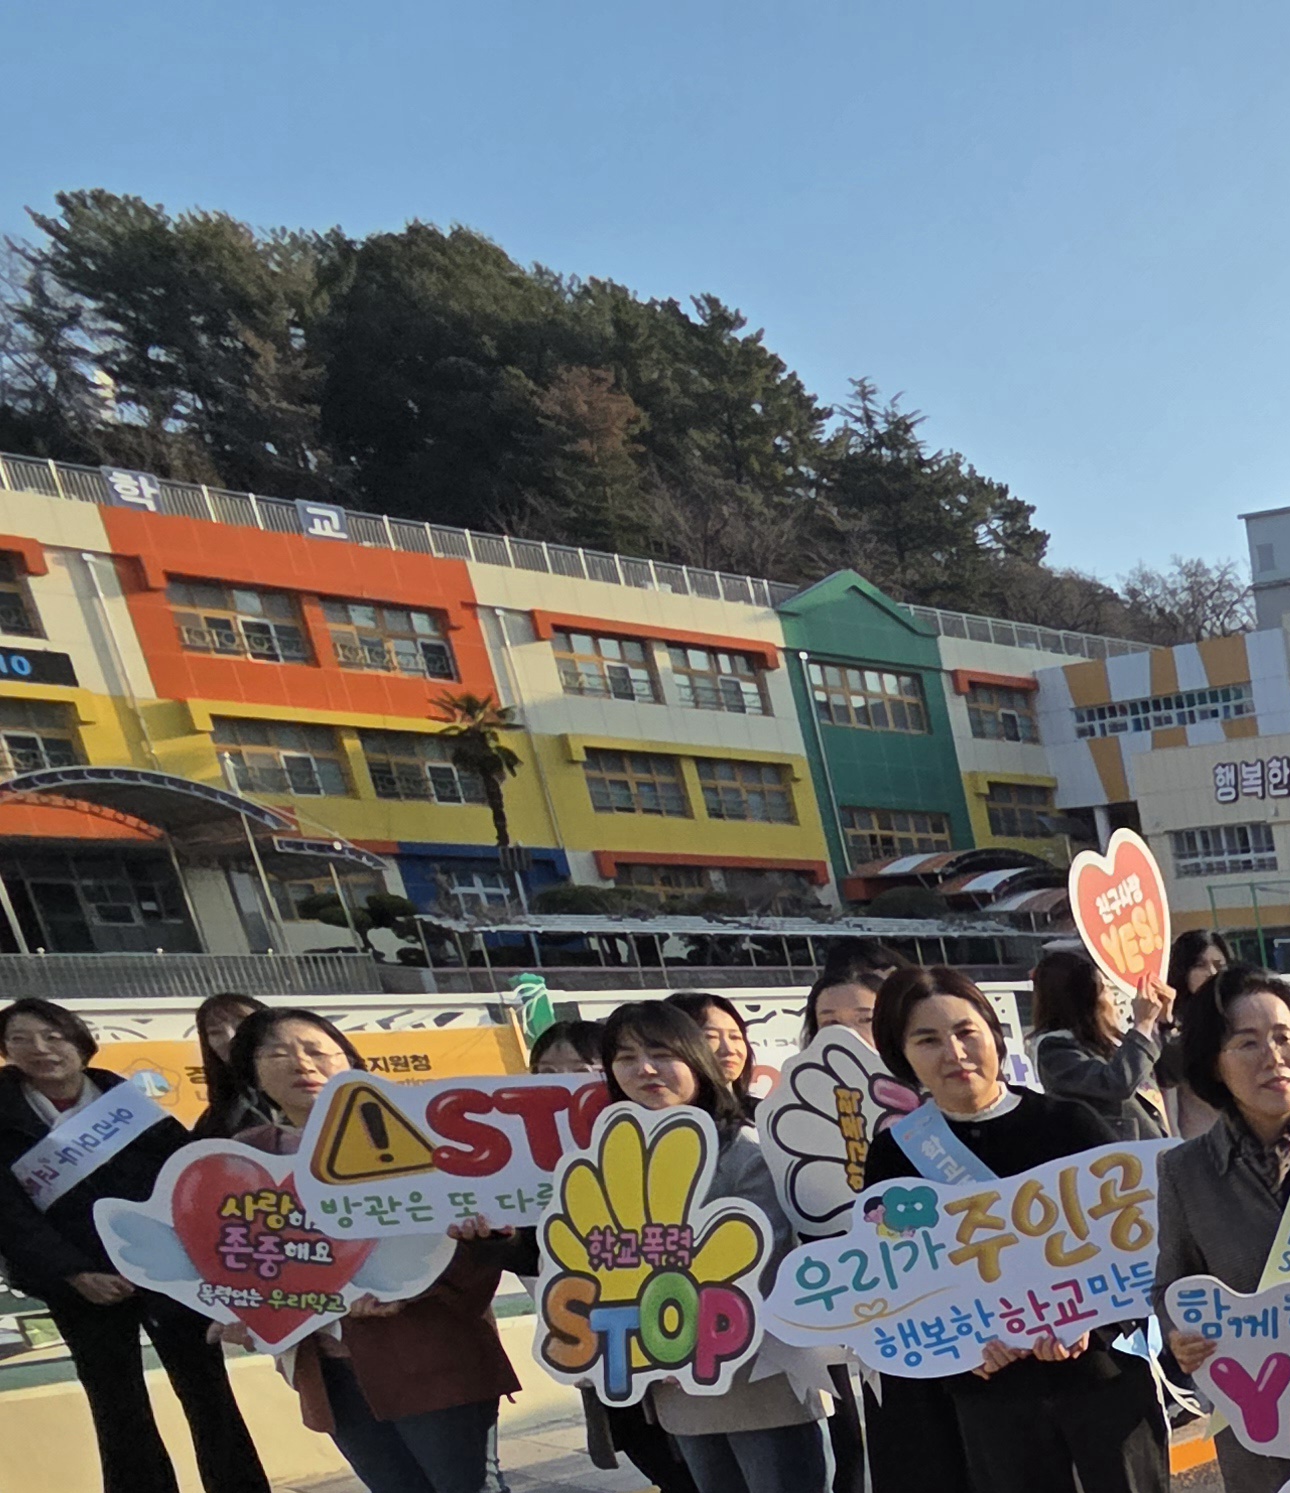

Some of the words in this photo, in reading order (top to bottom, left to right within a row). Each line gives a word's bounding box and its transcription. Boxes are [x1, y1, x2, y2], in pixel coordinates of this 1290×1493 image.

[1095, 872, 1143, 924] 친구사랑
[1100, 898, 1163, 974] YES!
[320, 1190, 434, 1229] 방관은
[446, 1191, 481, 1219] 또
[794, 1230, 947, 1311] 우리가
[943, 1151, 1158, 1283] 주인공
[218, 1224, 334, 1279] 존중해요
[587, 1224, 694, 1271] 학교폭력
[541, 1270, 756, 1402] STOP
[874, 1298, 1000, 1368] 행복한
